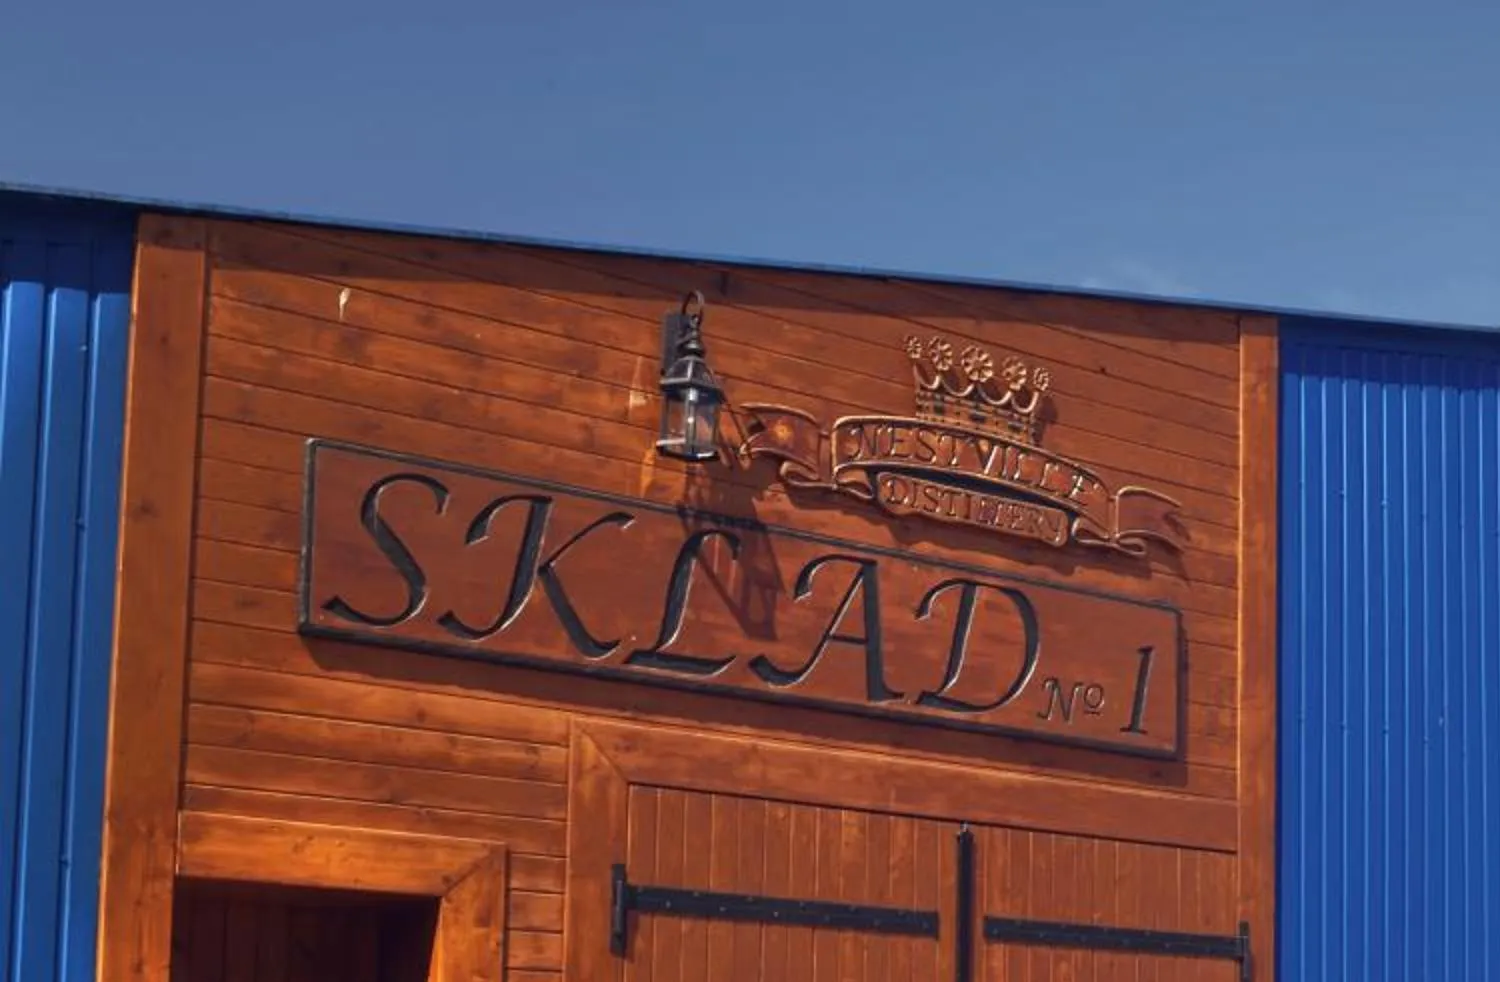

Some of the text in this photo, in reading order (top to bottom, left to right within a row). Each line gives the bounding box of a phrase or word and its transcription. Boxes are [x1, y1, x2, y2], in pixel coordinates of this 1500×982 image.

[845, 423, 1102, 503] NESTVILLE
[881, 475, 1067, 544] DISTILLERY
[322, 472, 1040, 713] SKLAD
[1119, 645, 1155, 735] 1
